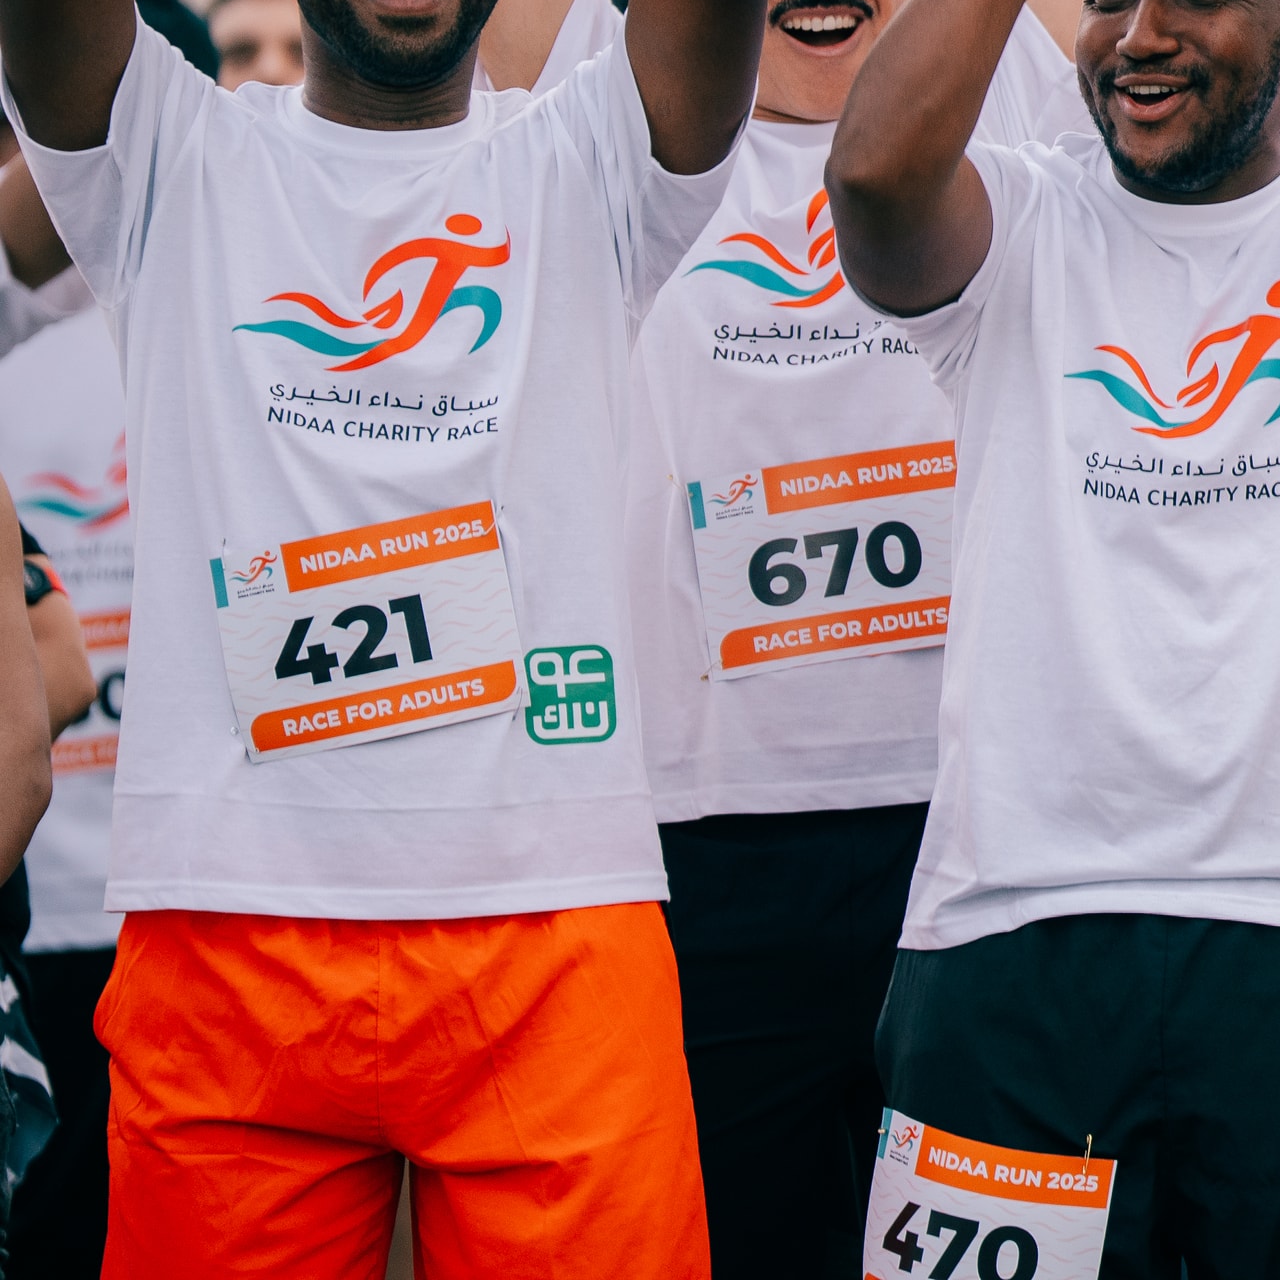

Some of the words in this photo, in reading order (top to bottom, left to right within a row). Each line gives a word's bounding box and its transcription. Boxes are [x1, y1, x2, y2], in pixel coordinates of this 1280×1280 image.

[714, 322, 801, 343] الخيري
[809, 322, 860, 341] نداء
[712, 346, 779, 365] NIDAA
[786, 338, 874, 366] CHARITY
[882, 338, 919, 355] RAC
[270, 384, 361, 406] الخيري
[368, 392, 423, 410] نداء
[432, 394, 498, 417] سباق
[267, 406, 335, 434] NIDAA
[343, 421, 440, 442] CHARITY
[447, 417, 499, 441] RACE
[780, 471, 853, 497] NIDAA
[857, 463, 903, 485] RUN
[907, 456, 954, 477] 2025
[1086, 452, 1164, 474] الخيري
[1171, 458, 1225, 476] نداء
[1083, 478, 1141, 504] NIDAA
[1147, 486, 1239, 507] CHARITY
[299, 543, 377, 574] NIDAA
[380, 531, 429, 556] RUN
[432, 519, 485, 546] 2025
[748, 520, 923, 607] 670
[274, 593, 433, 685] 421
[753, 627, 812, 653] RACE
[818, 618, 862, 641] FOR
[867, 607, 948, 634] ADULTS
[282, 710, 341, 737] RACE
[345, 698, 393, 723] FOR
[399, 678, 485, 713] ADULTS
[928, 1146, 989, 1180] NIDAA
[994, 1164, 1042, 1188] RUN
[1046, 1172, 1099, 1193] 2025
[882, 1201, 1039, 1280] 470
